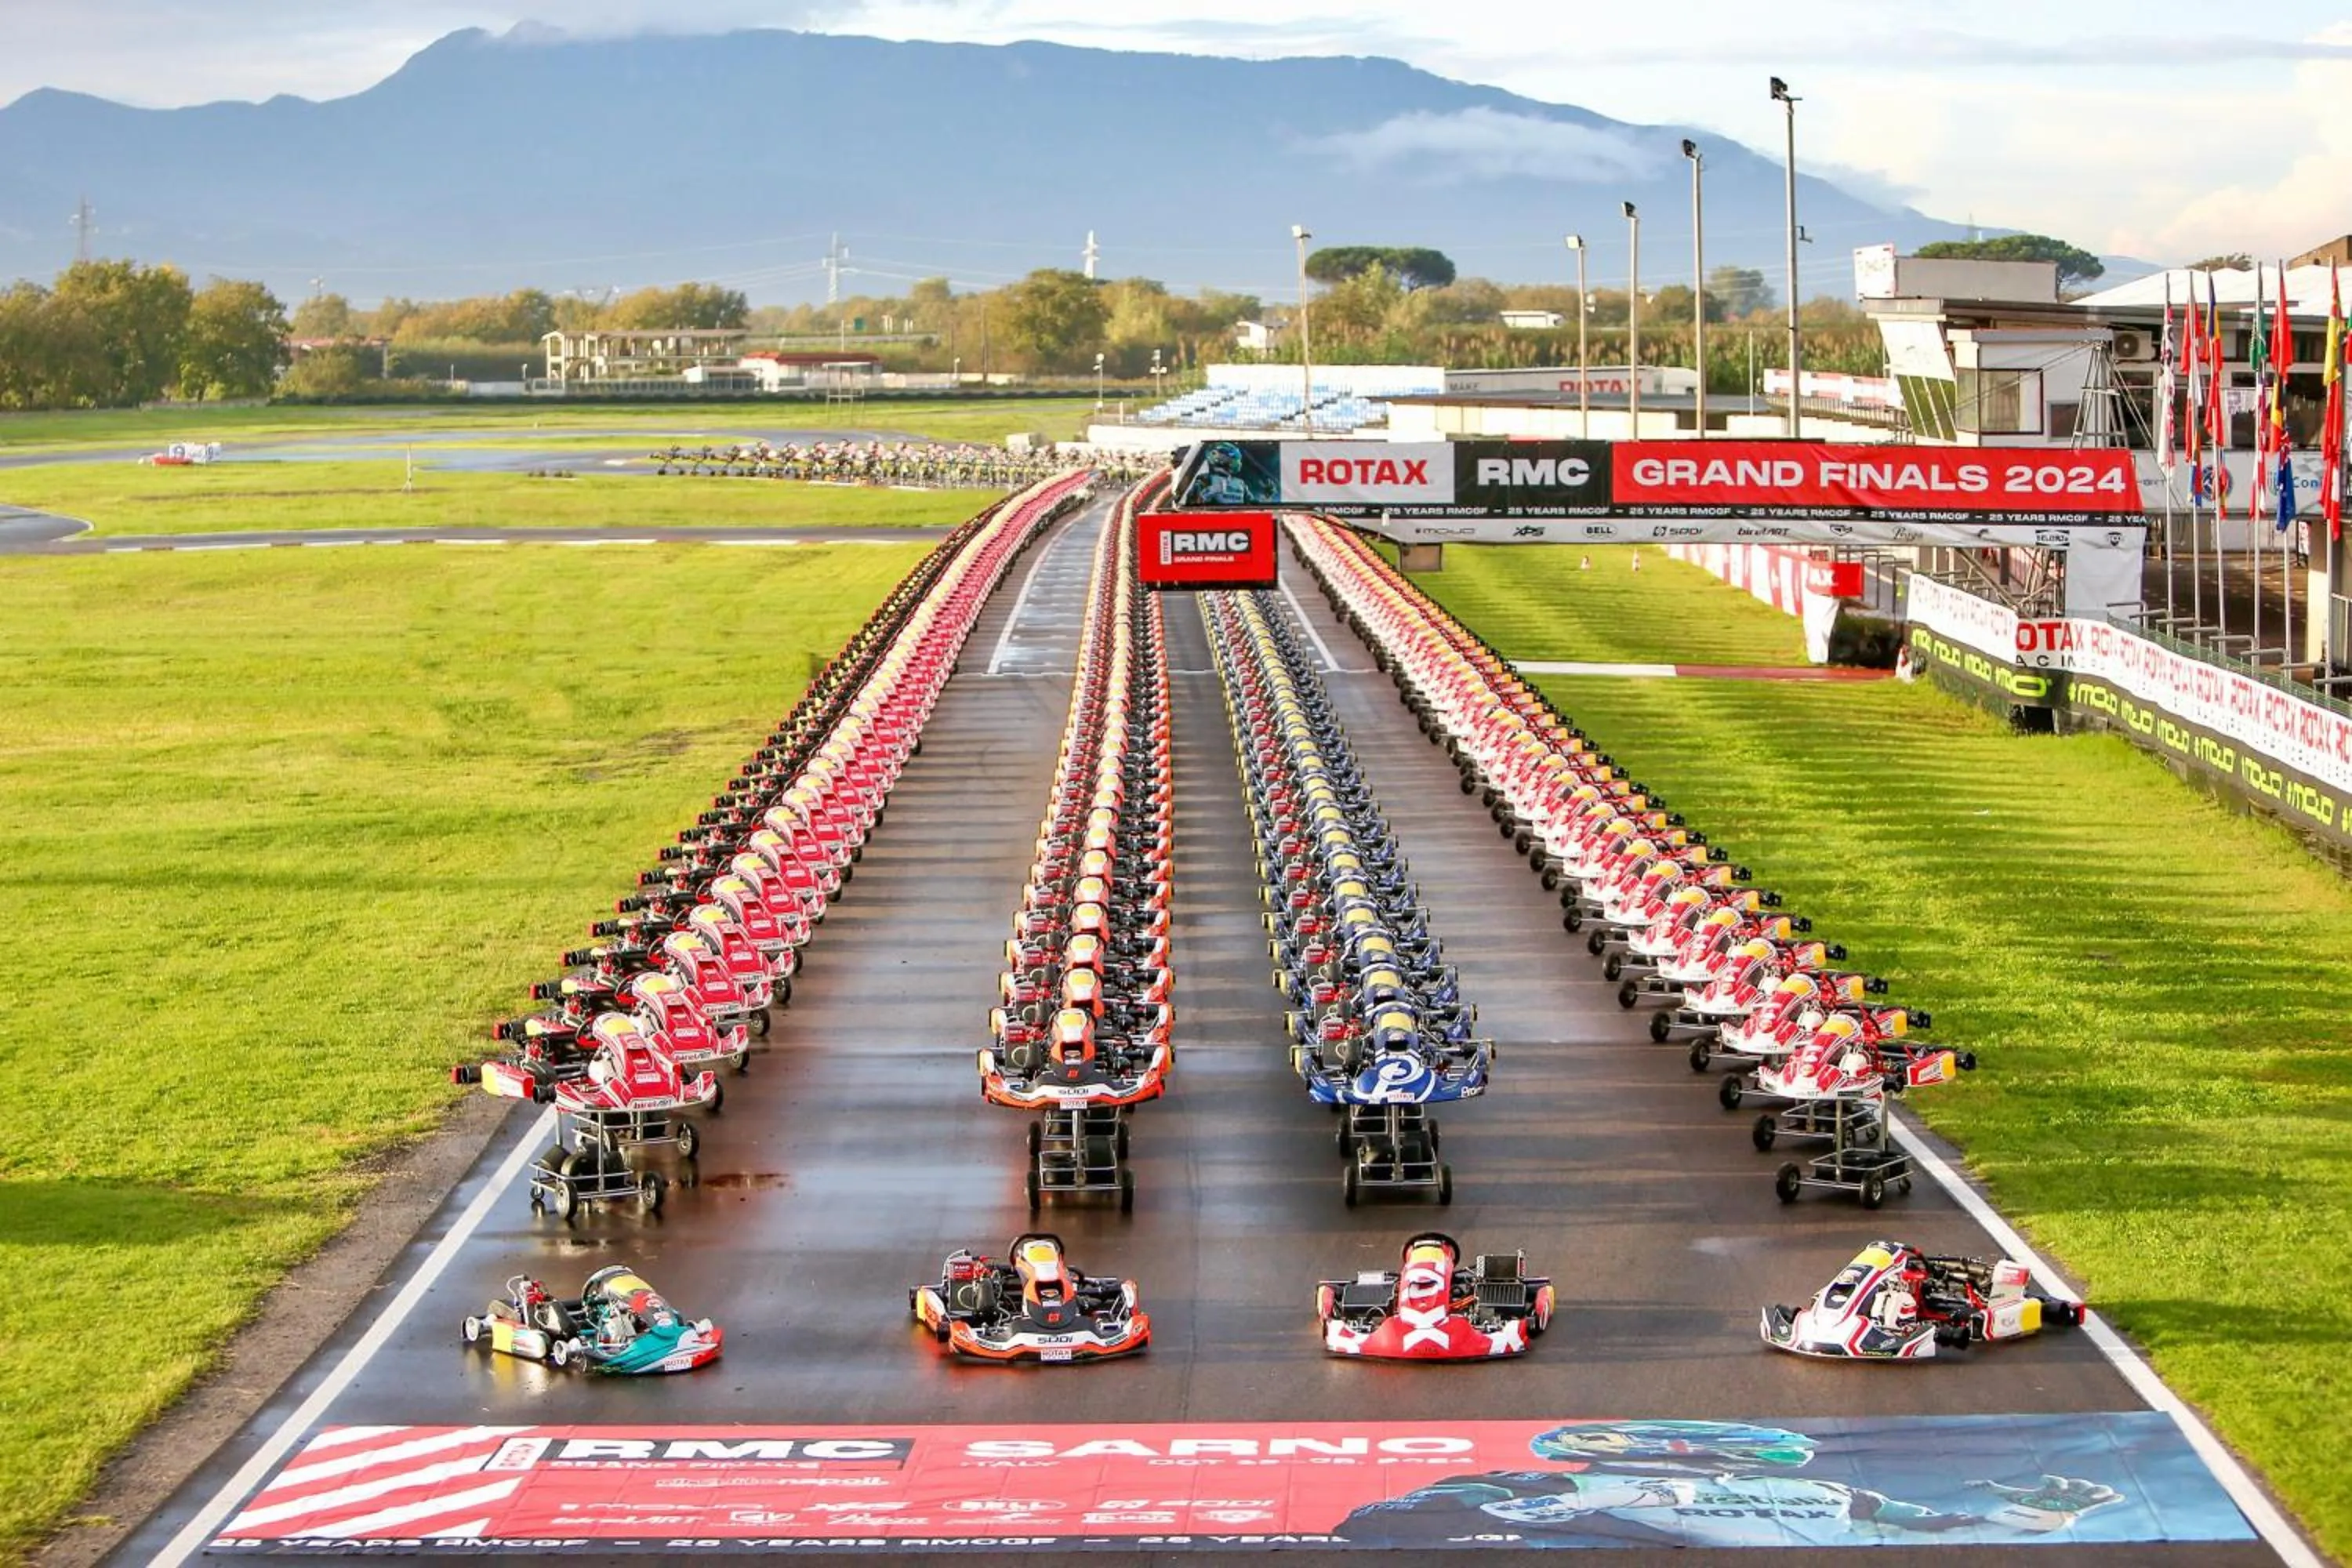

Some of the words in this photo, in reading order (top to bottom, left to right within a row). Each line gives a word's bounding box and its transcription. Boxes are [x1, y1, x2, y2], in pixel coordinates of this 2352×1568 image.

[1300, 459, 1428, 485] ROTAX
[1477, 458, 1590, 486] RMC
[1632, 459, 1805, 487] GRAND
[1819, 461, 1990, 492] FINALS
[2004, 465, 2126, 494] 2024
[1649, 507, 1686, 516] YEARS
[1751, 507, 1766, 516] 25
[1811, 509, 1851, 517] RMCGF
[1889, 511, 1926, 520] YEARS
[1929, 512, 1969, 521] RMCGF
[1989, 513, 2004, 521] 25
[2007, 514, 2045, 522] YEARS
[2107, 514, 2122, 523] 25
[1173, 532, 1249, 552] RMC
[557, 1439, 896, 1459] RMC
[964, 1436, 1475, 1458] SARNO
[550, 1461, 678, 1469] GRAND
[1672, 1508, 1835, 1519] ROTAX
[209, 1538, 263, 1548] 25
[278, 1539, 423, 1548] YEARS
[434, 1539, 590, 1548] RMCGF
[900, 1537, 1058, 1546] RMCGF
[1137, 1536, 1192, 1544] 25
